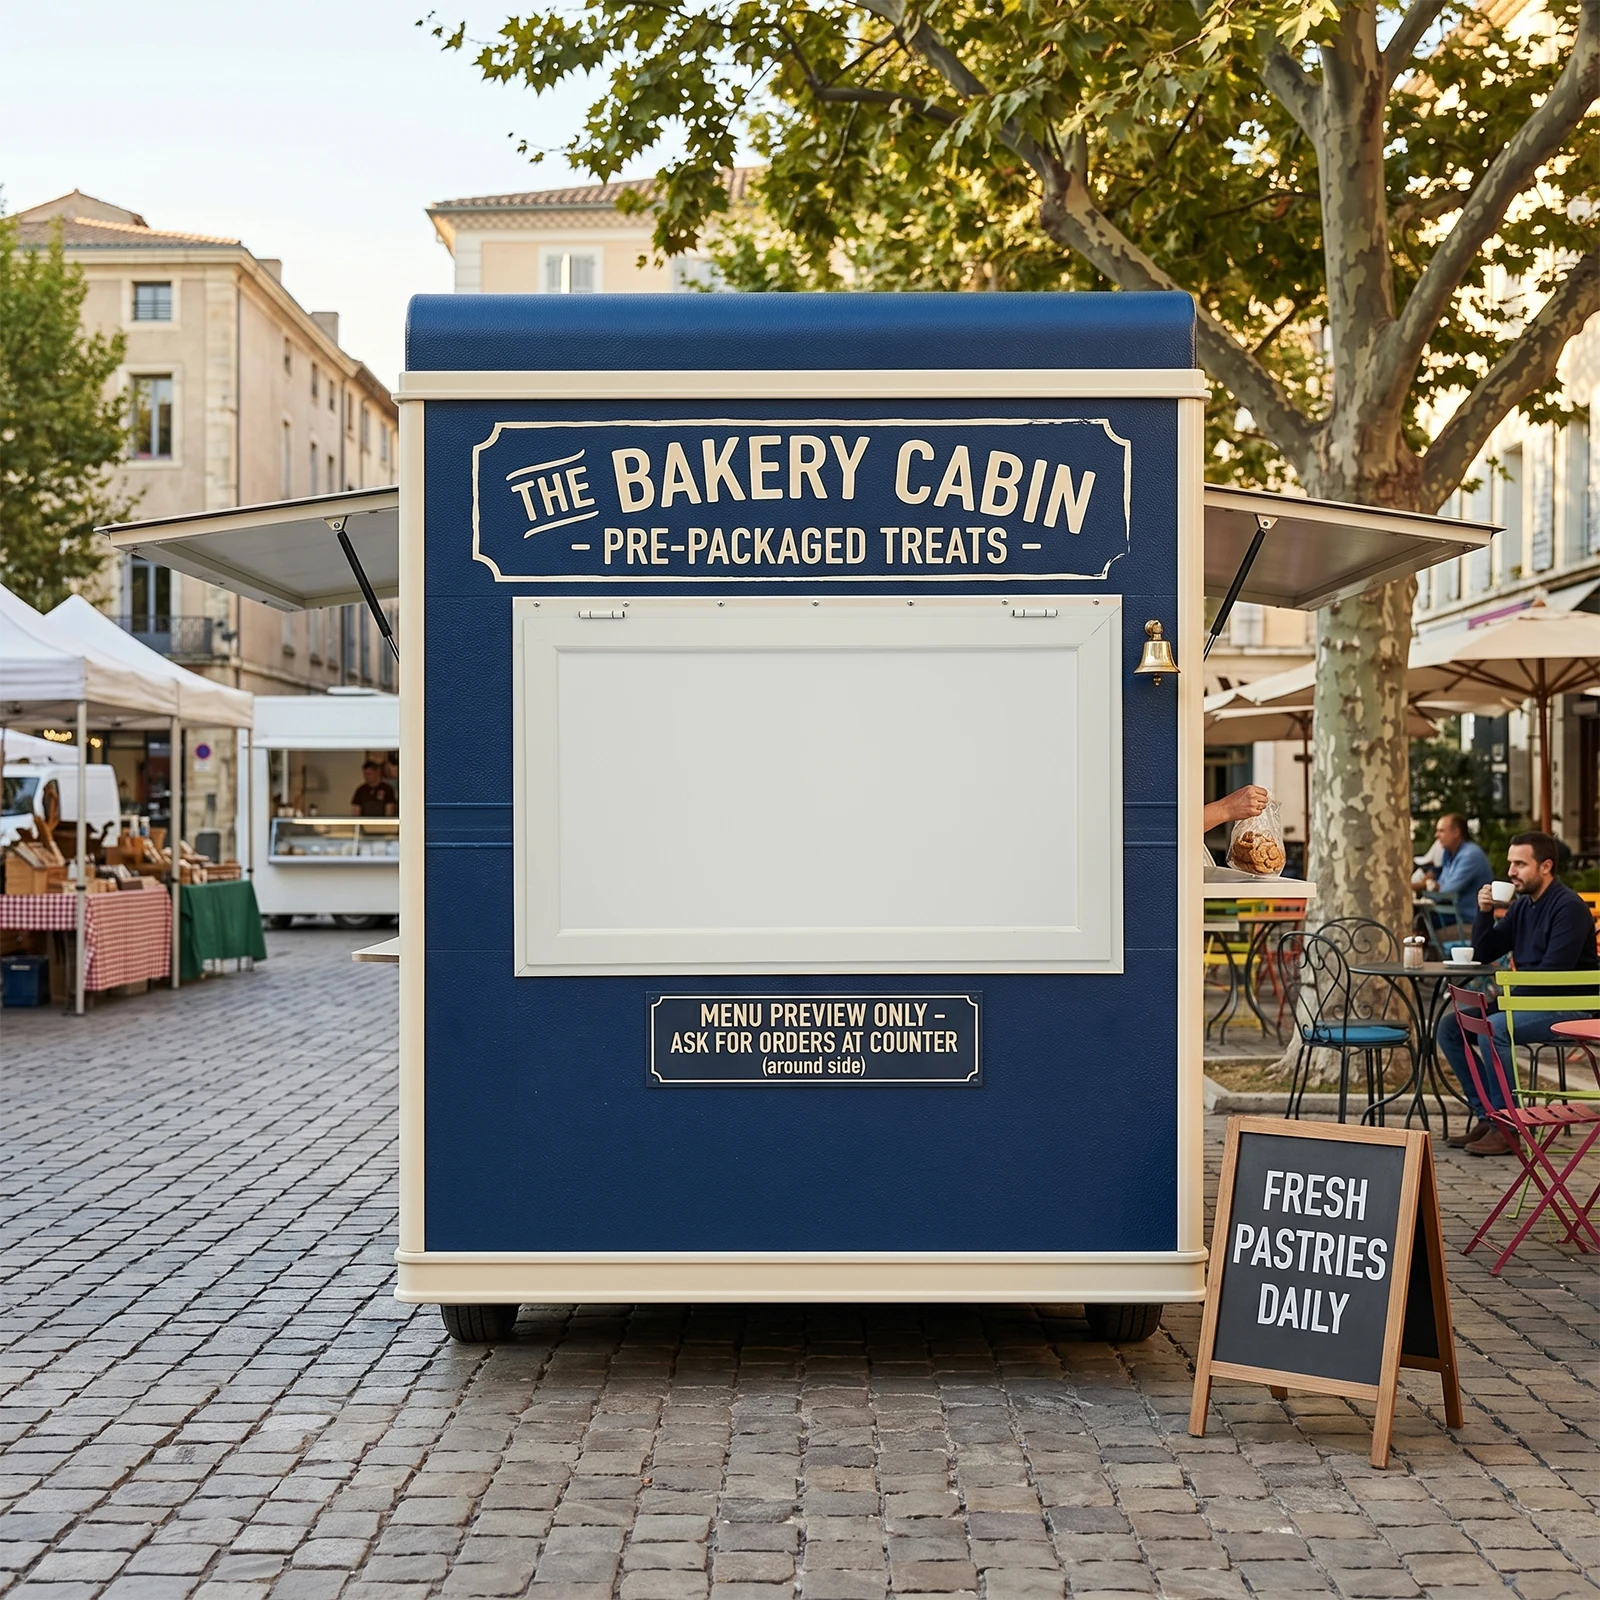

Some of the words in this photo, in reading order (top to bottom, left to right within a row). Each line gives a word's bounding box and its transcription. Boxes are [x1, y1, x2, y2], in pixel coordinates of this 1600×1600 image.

[509, 465, 597, 523] THE
[611, 434, 871, 514] BAKERY
[895, 439, 1096, 535] CABIN
[604, 527, 866, 565] PRE-PACKAGED
[879, 526, 1008, 564] TREATS
[700, 1003, 762, 1028] MENU
[770, 1002, 867, 1027] PREVIEW
[874, 1002, 928, 1027] ONLY
[670, 1031, 710, 1054] ASK
[715, 1031, 753, 1054] FOR
[759, 1031, 836, 1054] ORDERS
[841, 1031, 864, 1054] AT
[870, 1030, 958, 1054] COUNTER
[762, 1055, 823, 1077] (around
[827, 1055, 866, 1077] side)
[1262, 1169, 1369, 1221] FRESH
[1232, 1223, 1388, 1281] PASTRIES
[1256, 1282, 1350, 1335] DAILY
